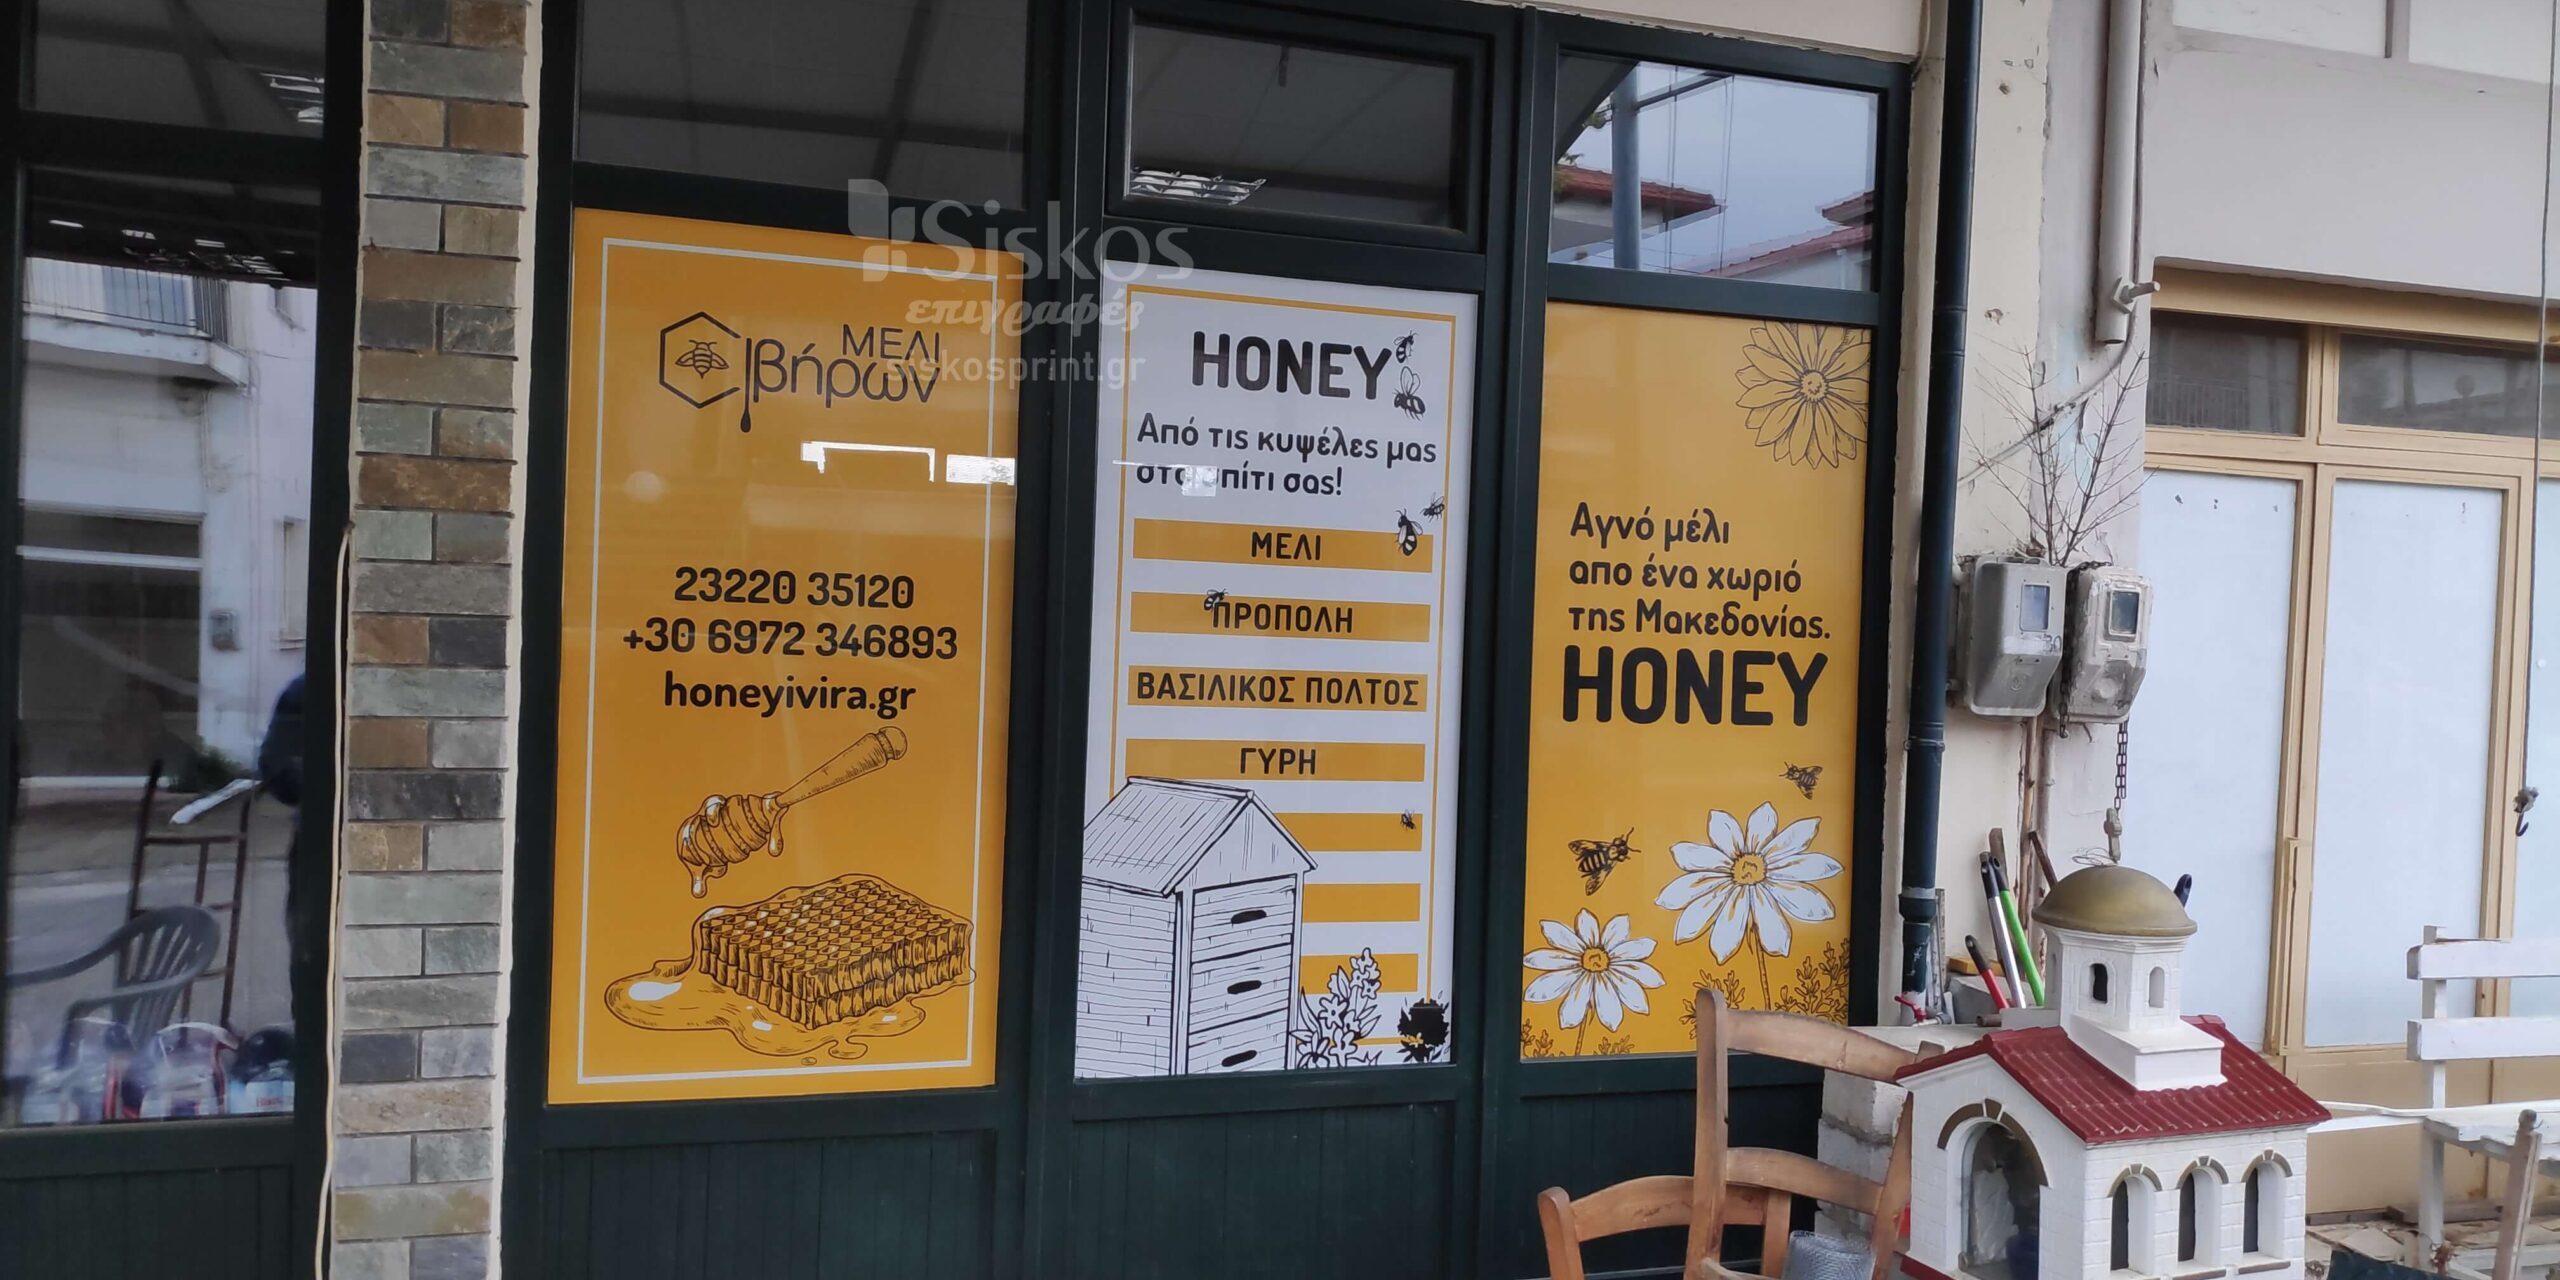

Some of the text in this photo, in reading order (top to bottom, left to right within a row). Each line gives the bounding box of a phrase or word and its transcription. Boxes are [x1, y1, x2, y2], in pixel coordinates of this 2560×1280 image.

[842, 324, 940, 363] ΜΕΛΙ
[1192, 331, 1392, 400] HONEY
[1137, 413, 1437, 469] Από τις κυψέλες μας
[1283, 467, 1342, 495] σας!
[1251, 532, 1321, 560] ΜΕΛΙ
[1570, 502, 1729, 552] Αγνό μέλι
[674, 567, 914, 608] 23220 35120
[1569, 553, 1802, 601] απο ένα χωριό
[1212, 602, 1353, 633] ΠΡΟΠΟΛΗ
[1568, 598, 1831, 640] της Μακεδονίας.
[623, 618, 958, 660] +30 6972 346893
[664, 670, 916, 720] honeyivira.gr
[1137, 672, 1419, 706] ΒΑΣΙΛΙΚΟΣ ΠΟΛΤΟΣ
[1562, 645, 1829, 727] HONEY
[1240, 747, 1316, 775] ΓΥΡΗ
